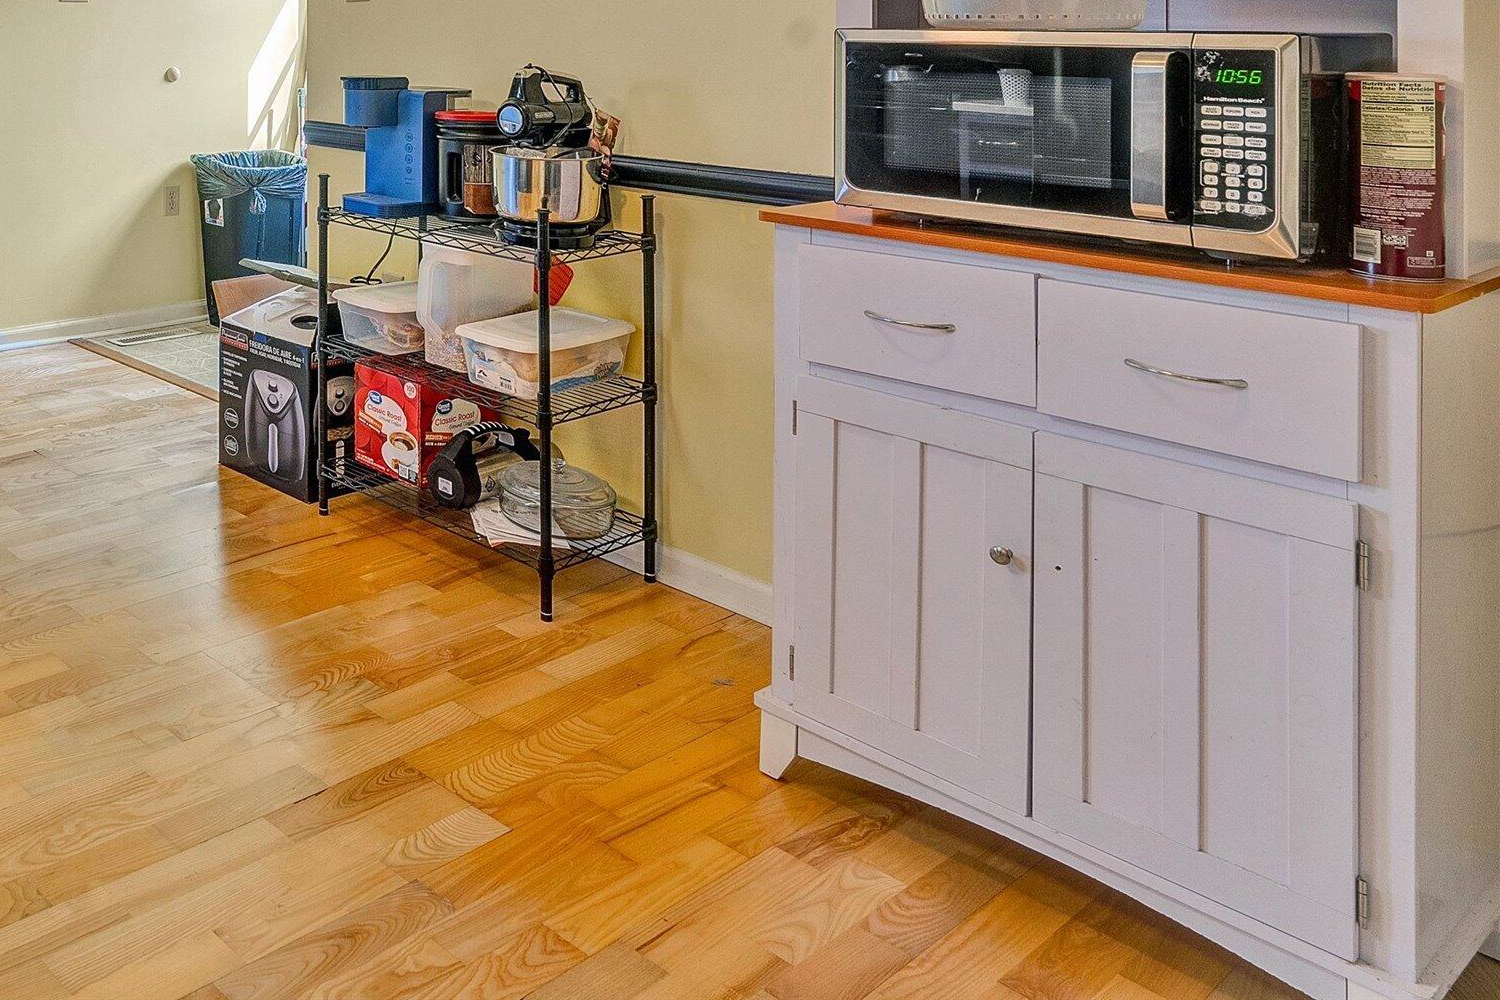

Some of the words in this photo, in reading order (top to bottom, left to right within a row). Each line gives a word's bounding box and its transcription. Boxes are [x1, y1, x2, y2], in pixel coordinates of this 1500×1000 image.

[1216, 69, 1262, 84] 10:56
[367, 403, 386, 416] Classic
[386, 410, 402, 421] Roast
[435, 415, 457, 427] Classic
[457, 411, 474, 421] Roast
